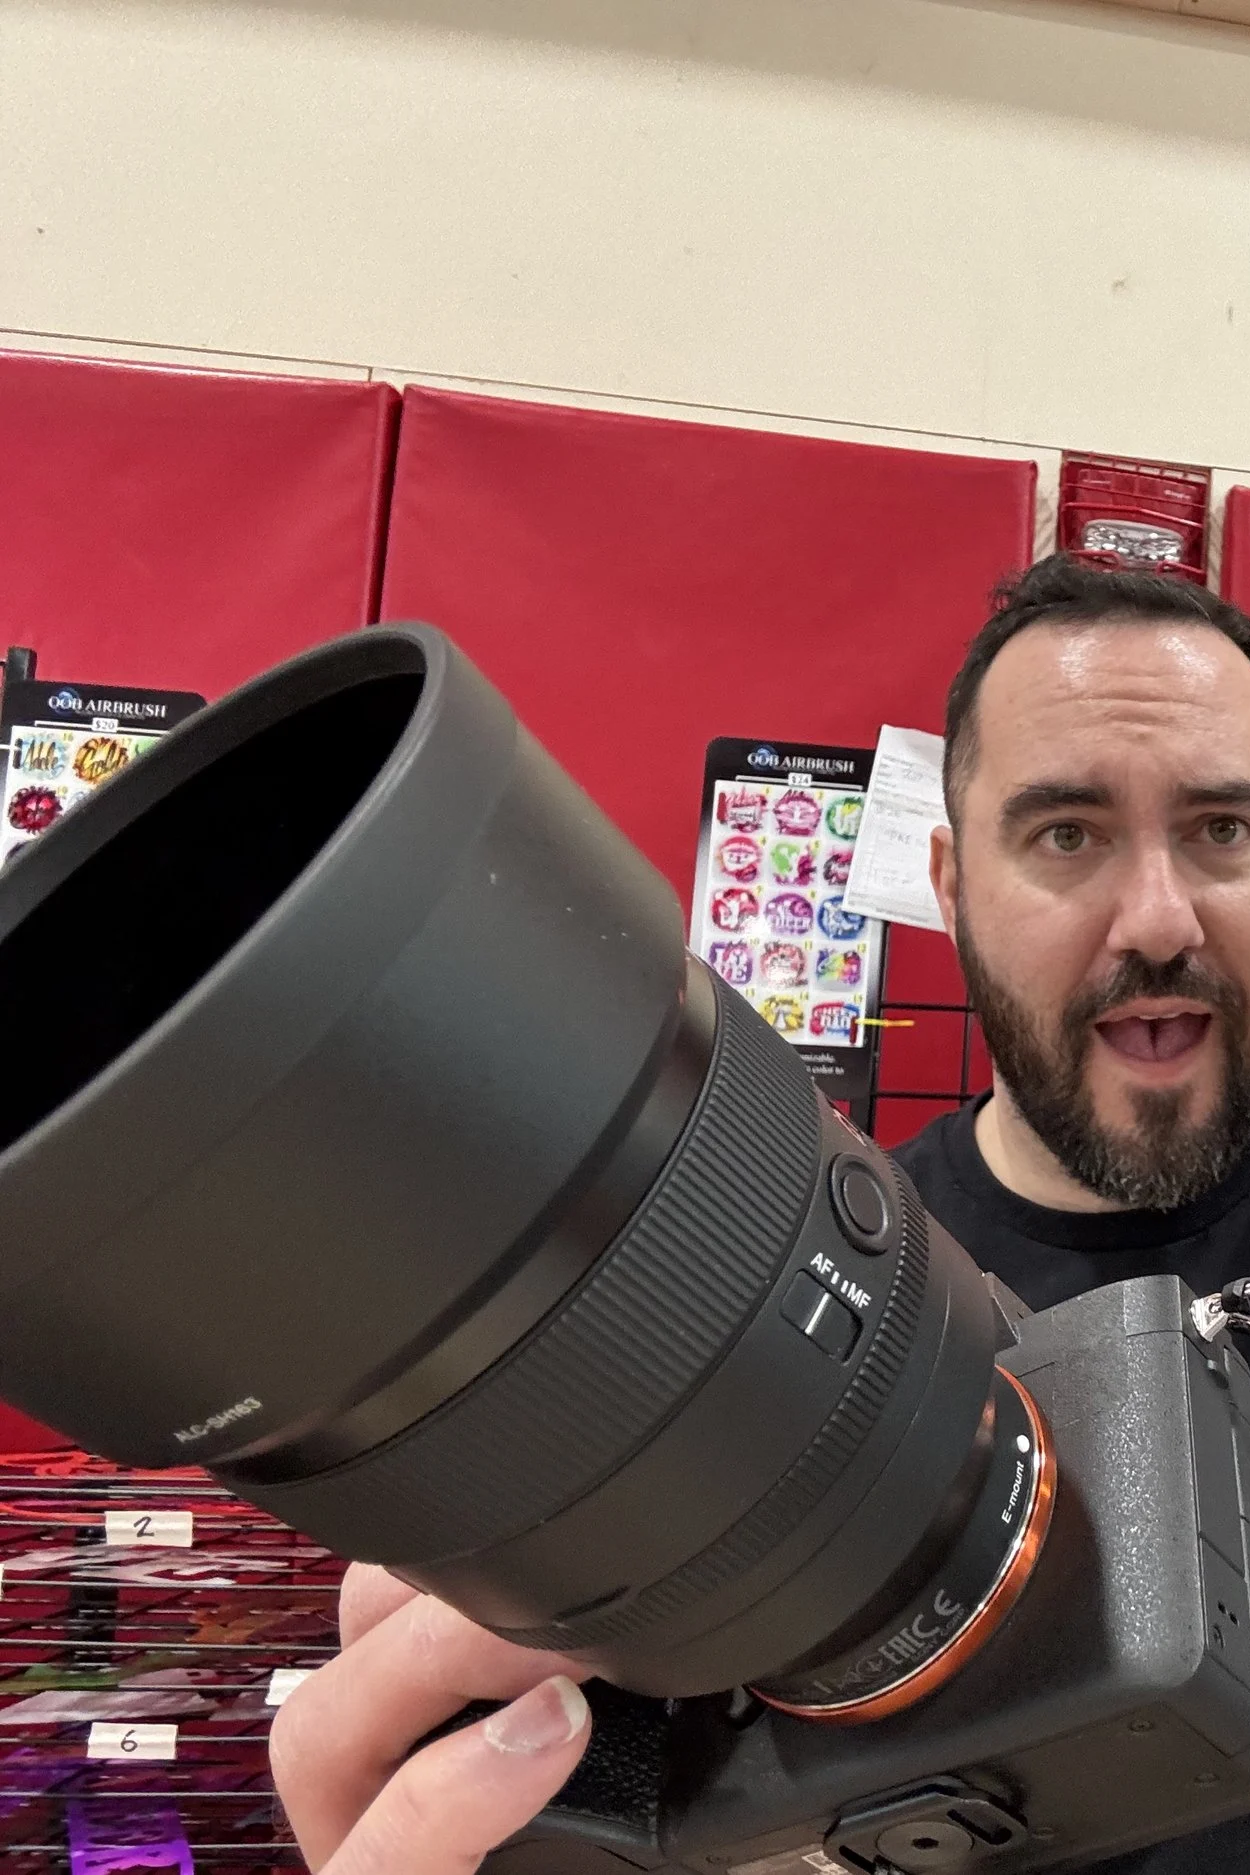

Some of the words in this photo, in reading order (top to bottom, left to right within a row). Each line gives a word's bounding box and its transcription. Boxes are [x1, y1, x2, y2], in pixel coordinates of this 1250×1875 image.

[84, 699, 167, 719] AIRBRUSH
[95, 720, 116, 730] $20
[780, 755, 856, 774] AIRBRUSH
[810, 1252, 834, 1274] AF
[846, 1282, 872, 1309] MF
[1001, 1460, 1025, 1524] E-mount
[133, 1516, 155, 1538] 2
[120, 1729, 138, 1753] 6
